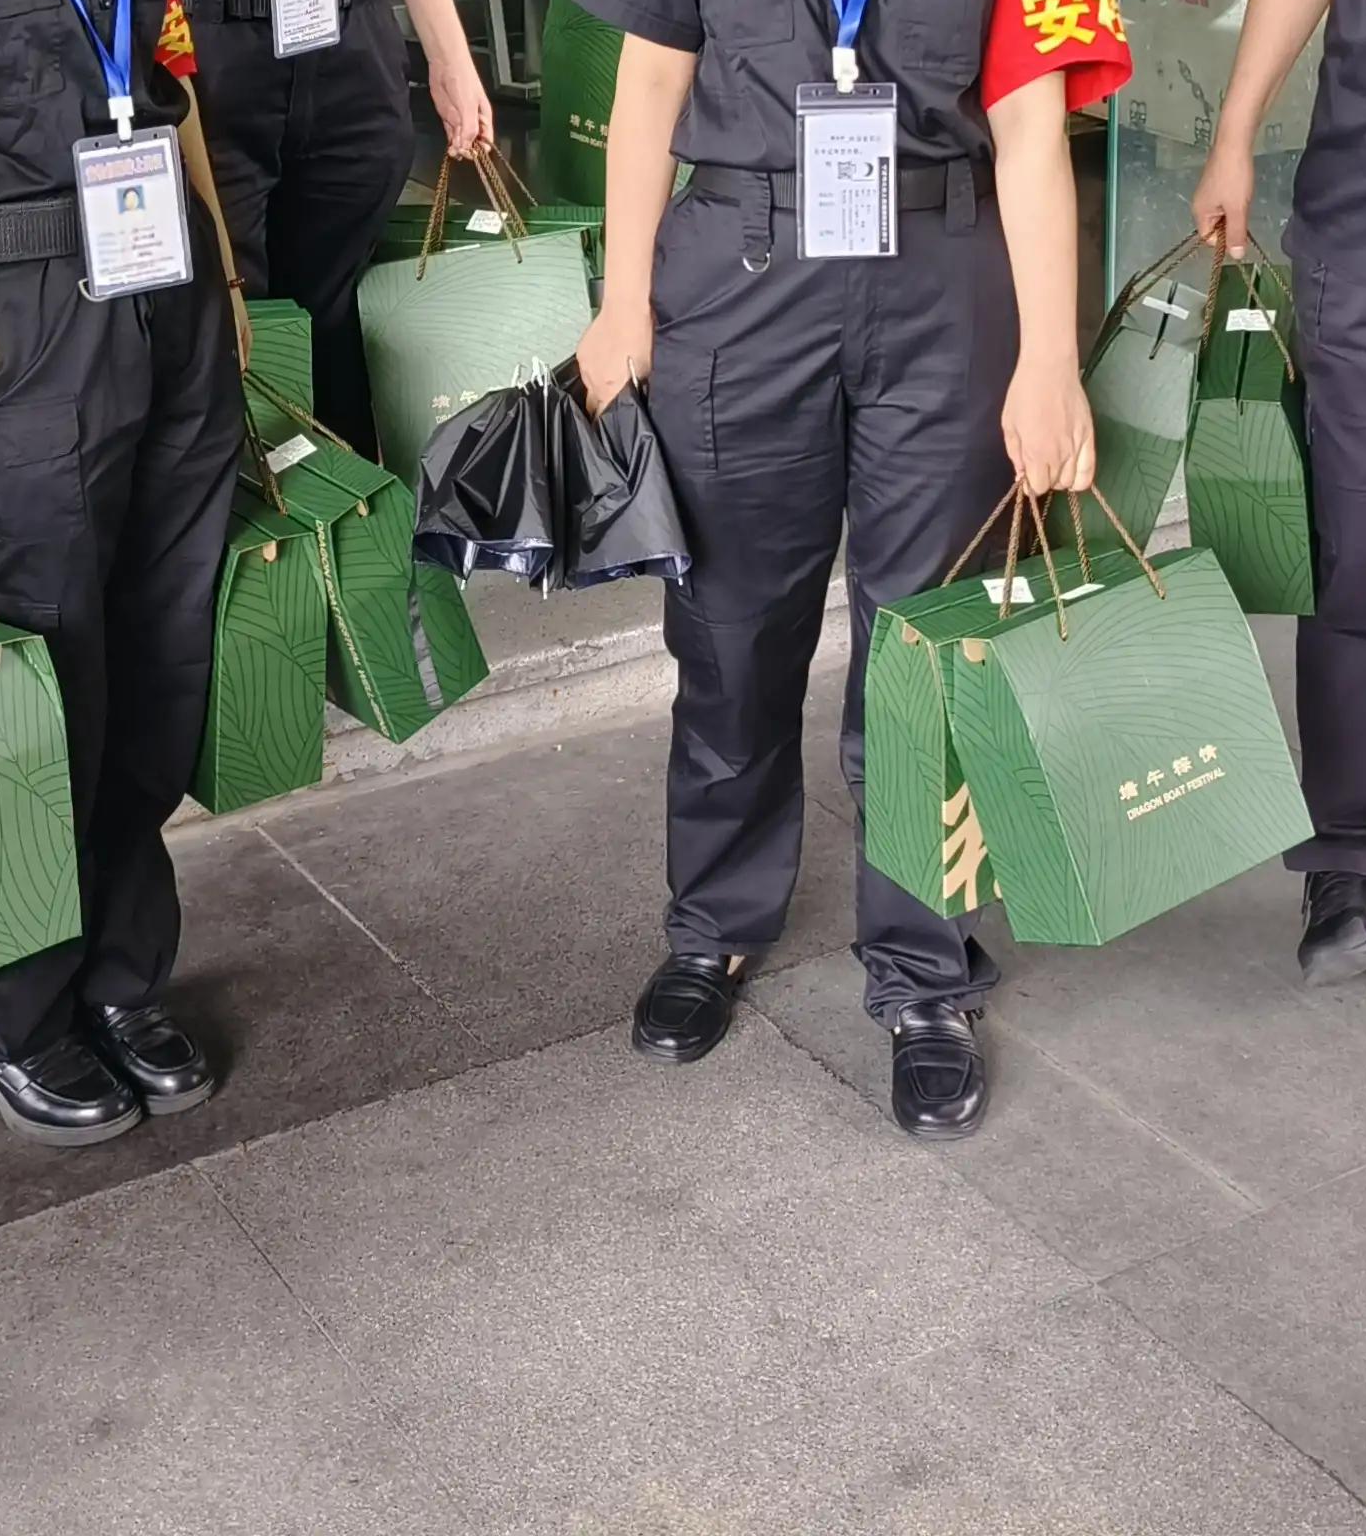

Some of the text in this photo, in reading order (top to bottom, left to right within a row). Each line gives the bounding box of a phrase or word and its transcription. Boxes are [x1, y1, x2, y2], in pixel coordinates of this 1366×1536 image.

[1126, 767, 1226, 821] DRAGON BOAT FESTIVAL
